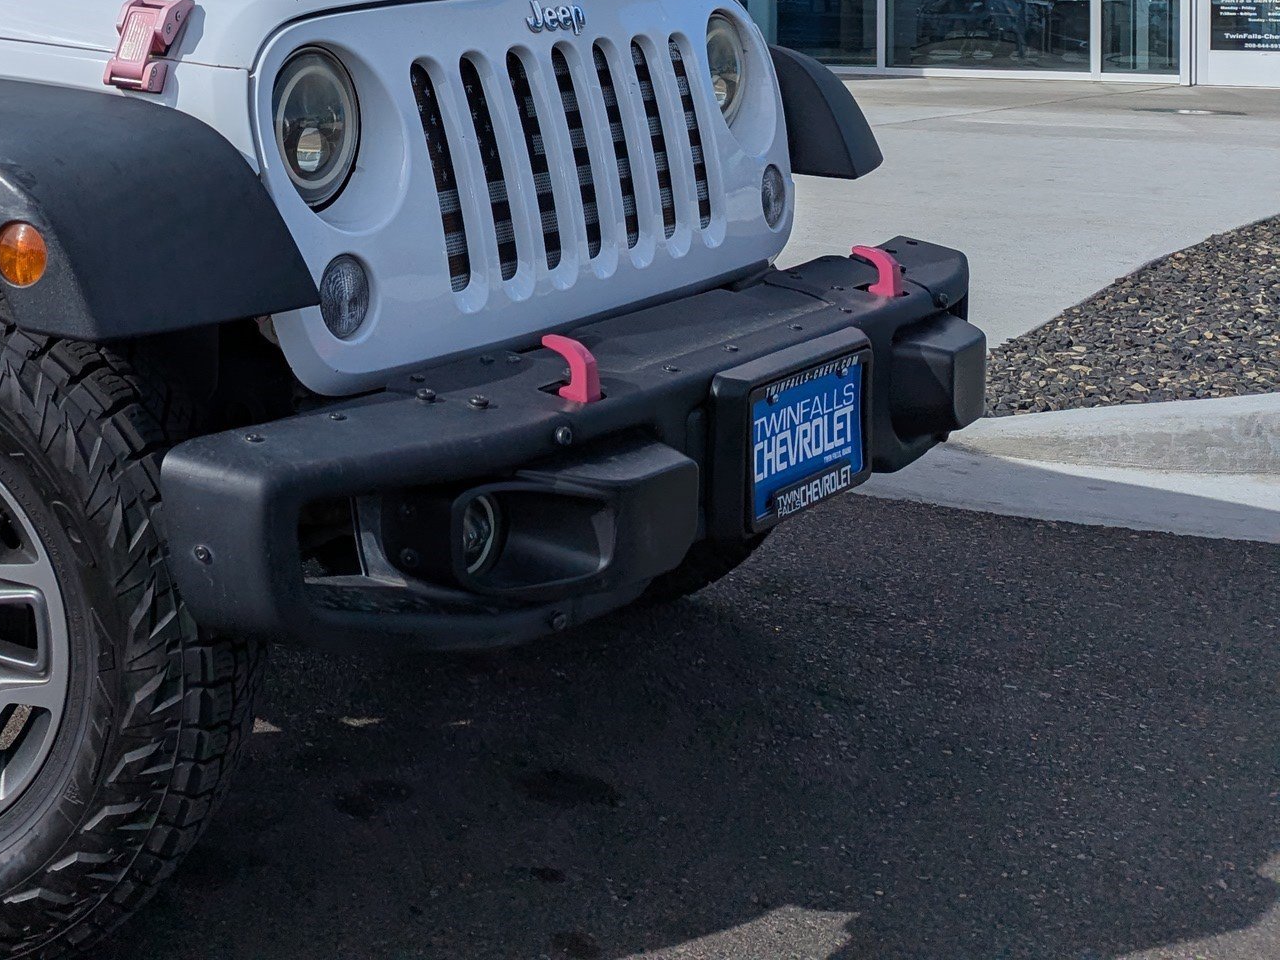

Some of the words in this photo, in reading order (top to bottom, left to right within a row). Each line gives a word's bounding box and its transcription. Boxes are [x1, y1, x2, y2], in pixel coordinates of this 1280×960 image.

[526, 0, 586, 36] Jeep
[754, 383, 855, 442] TWINFALLS
[754, 405, 854, 483] CHEVROLET
[777, 492, 800, 509] TWIN
[800, 464, 852, 508] CHEVROLET
[778, 499, 801, 518] FALLS
